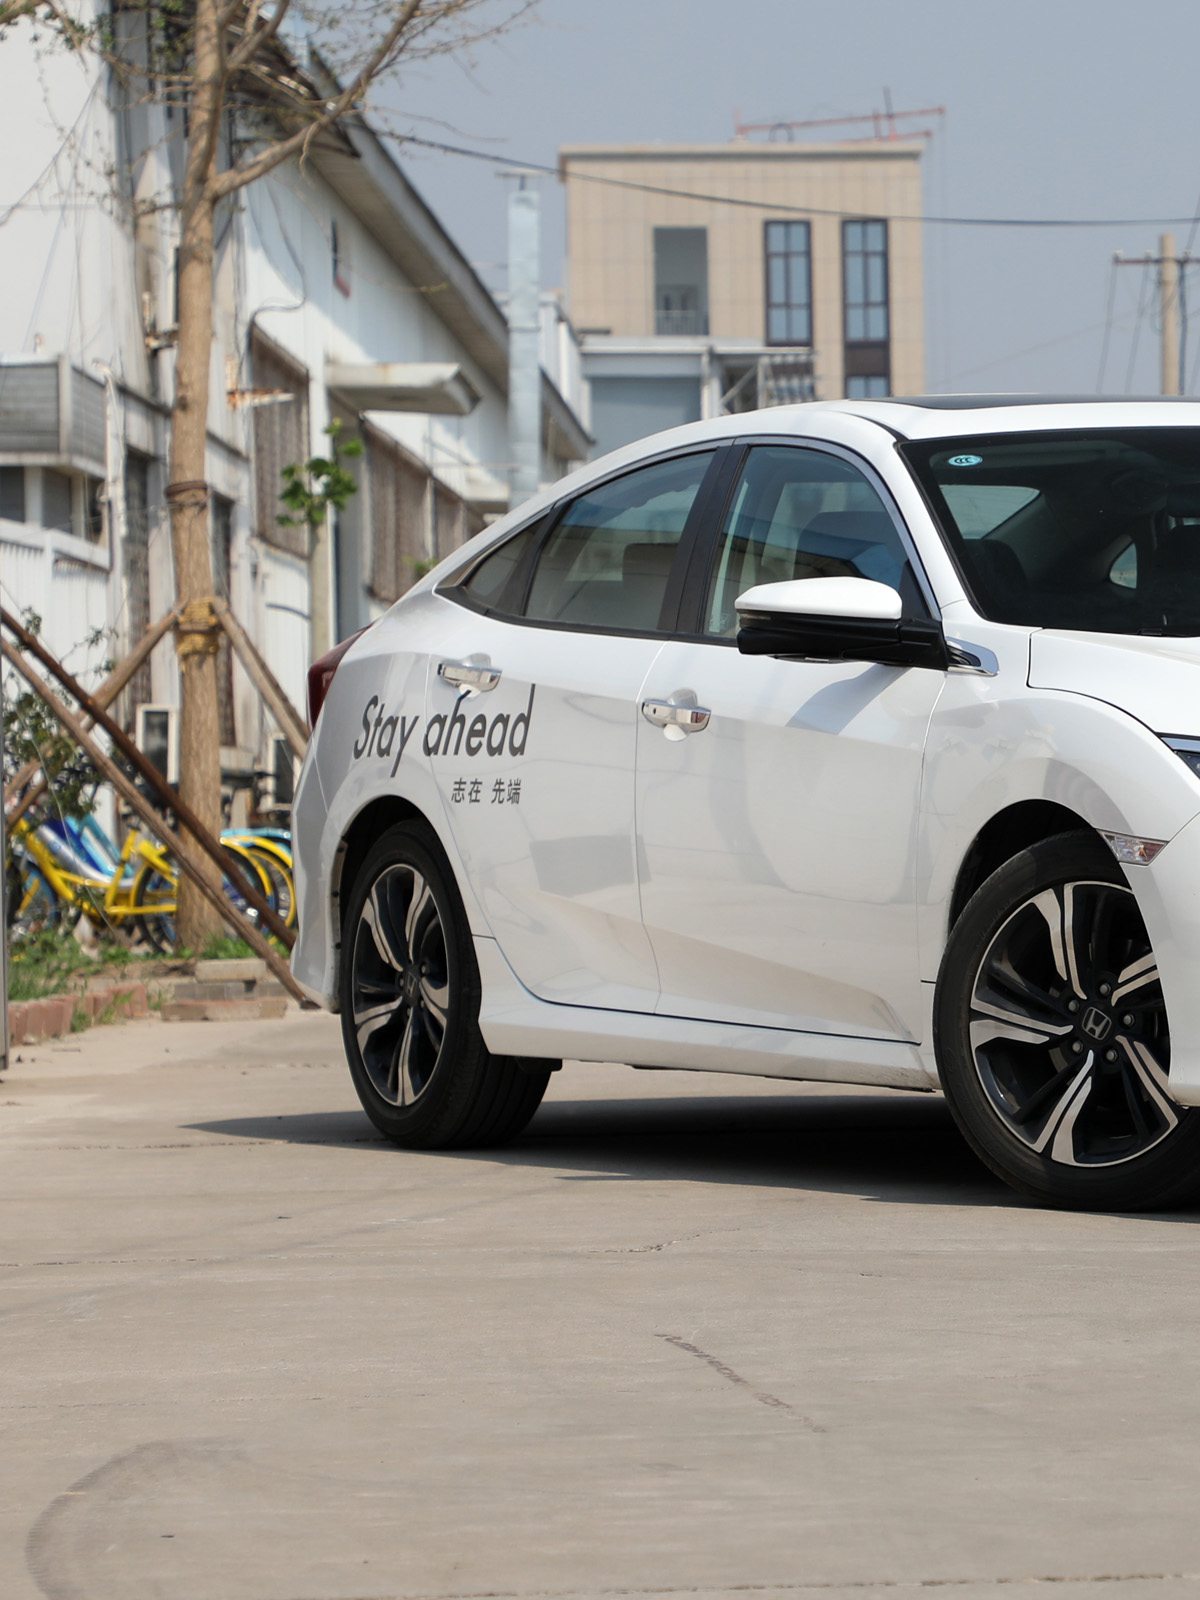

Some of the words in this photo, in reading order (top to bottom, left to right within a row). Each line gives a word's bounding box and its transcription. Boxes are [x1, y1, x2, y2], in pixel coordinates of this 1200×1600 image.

[353, 695, 419, 778] Stay
[423, 683, 535, 757] ahead
[451, 777, 482, 804] 志在
[490, 778, 521, 804] 先端
